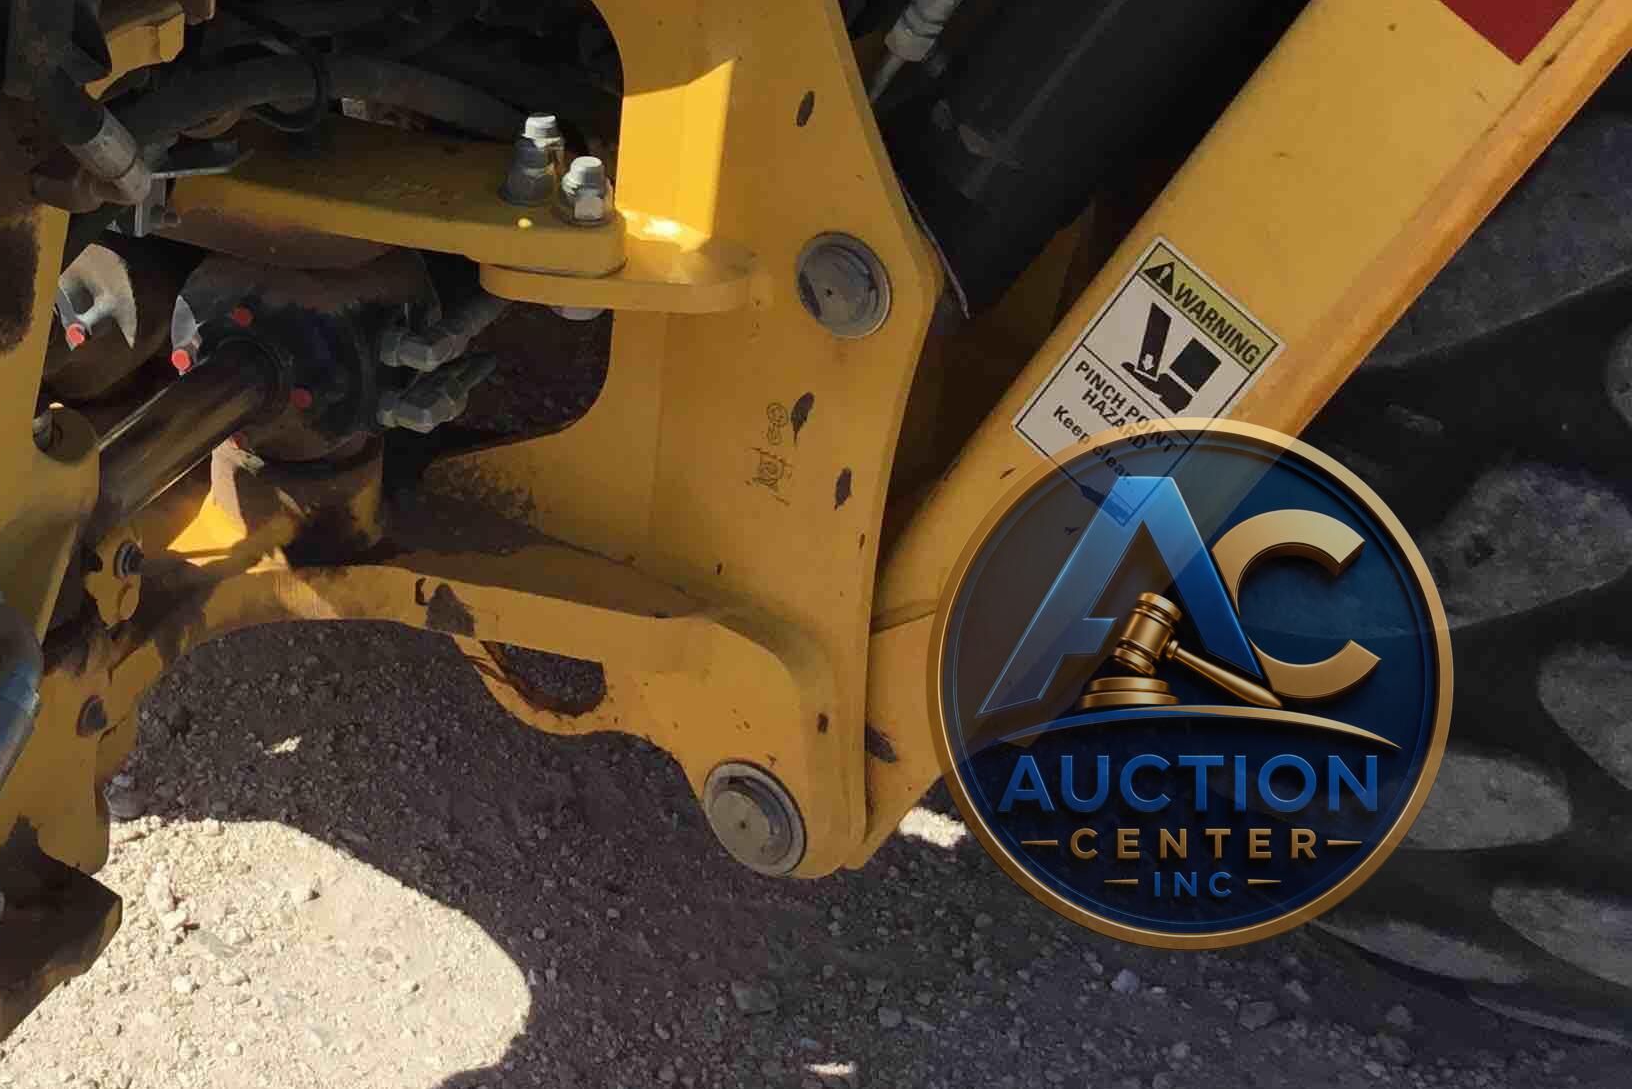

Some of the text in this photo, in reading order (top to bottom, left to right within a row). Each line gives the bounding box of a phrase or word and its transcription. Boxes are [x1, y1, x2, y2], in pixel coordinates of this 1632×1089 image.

[1173, 281, 1261, 365] WARNING
[1074, 360, 1131, 411] PINCH
[1052, 404, 1092, 448] Keep
[1081, 388, 1149, 451] HAZARD
